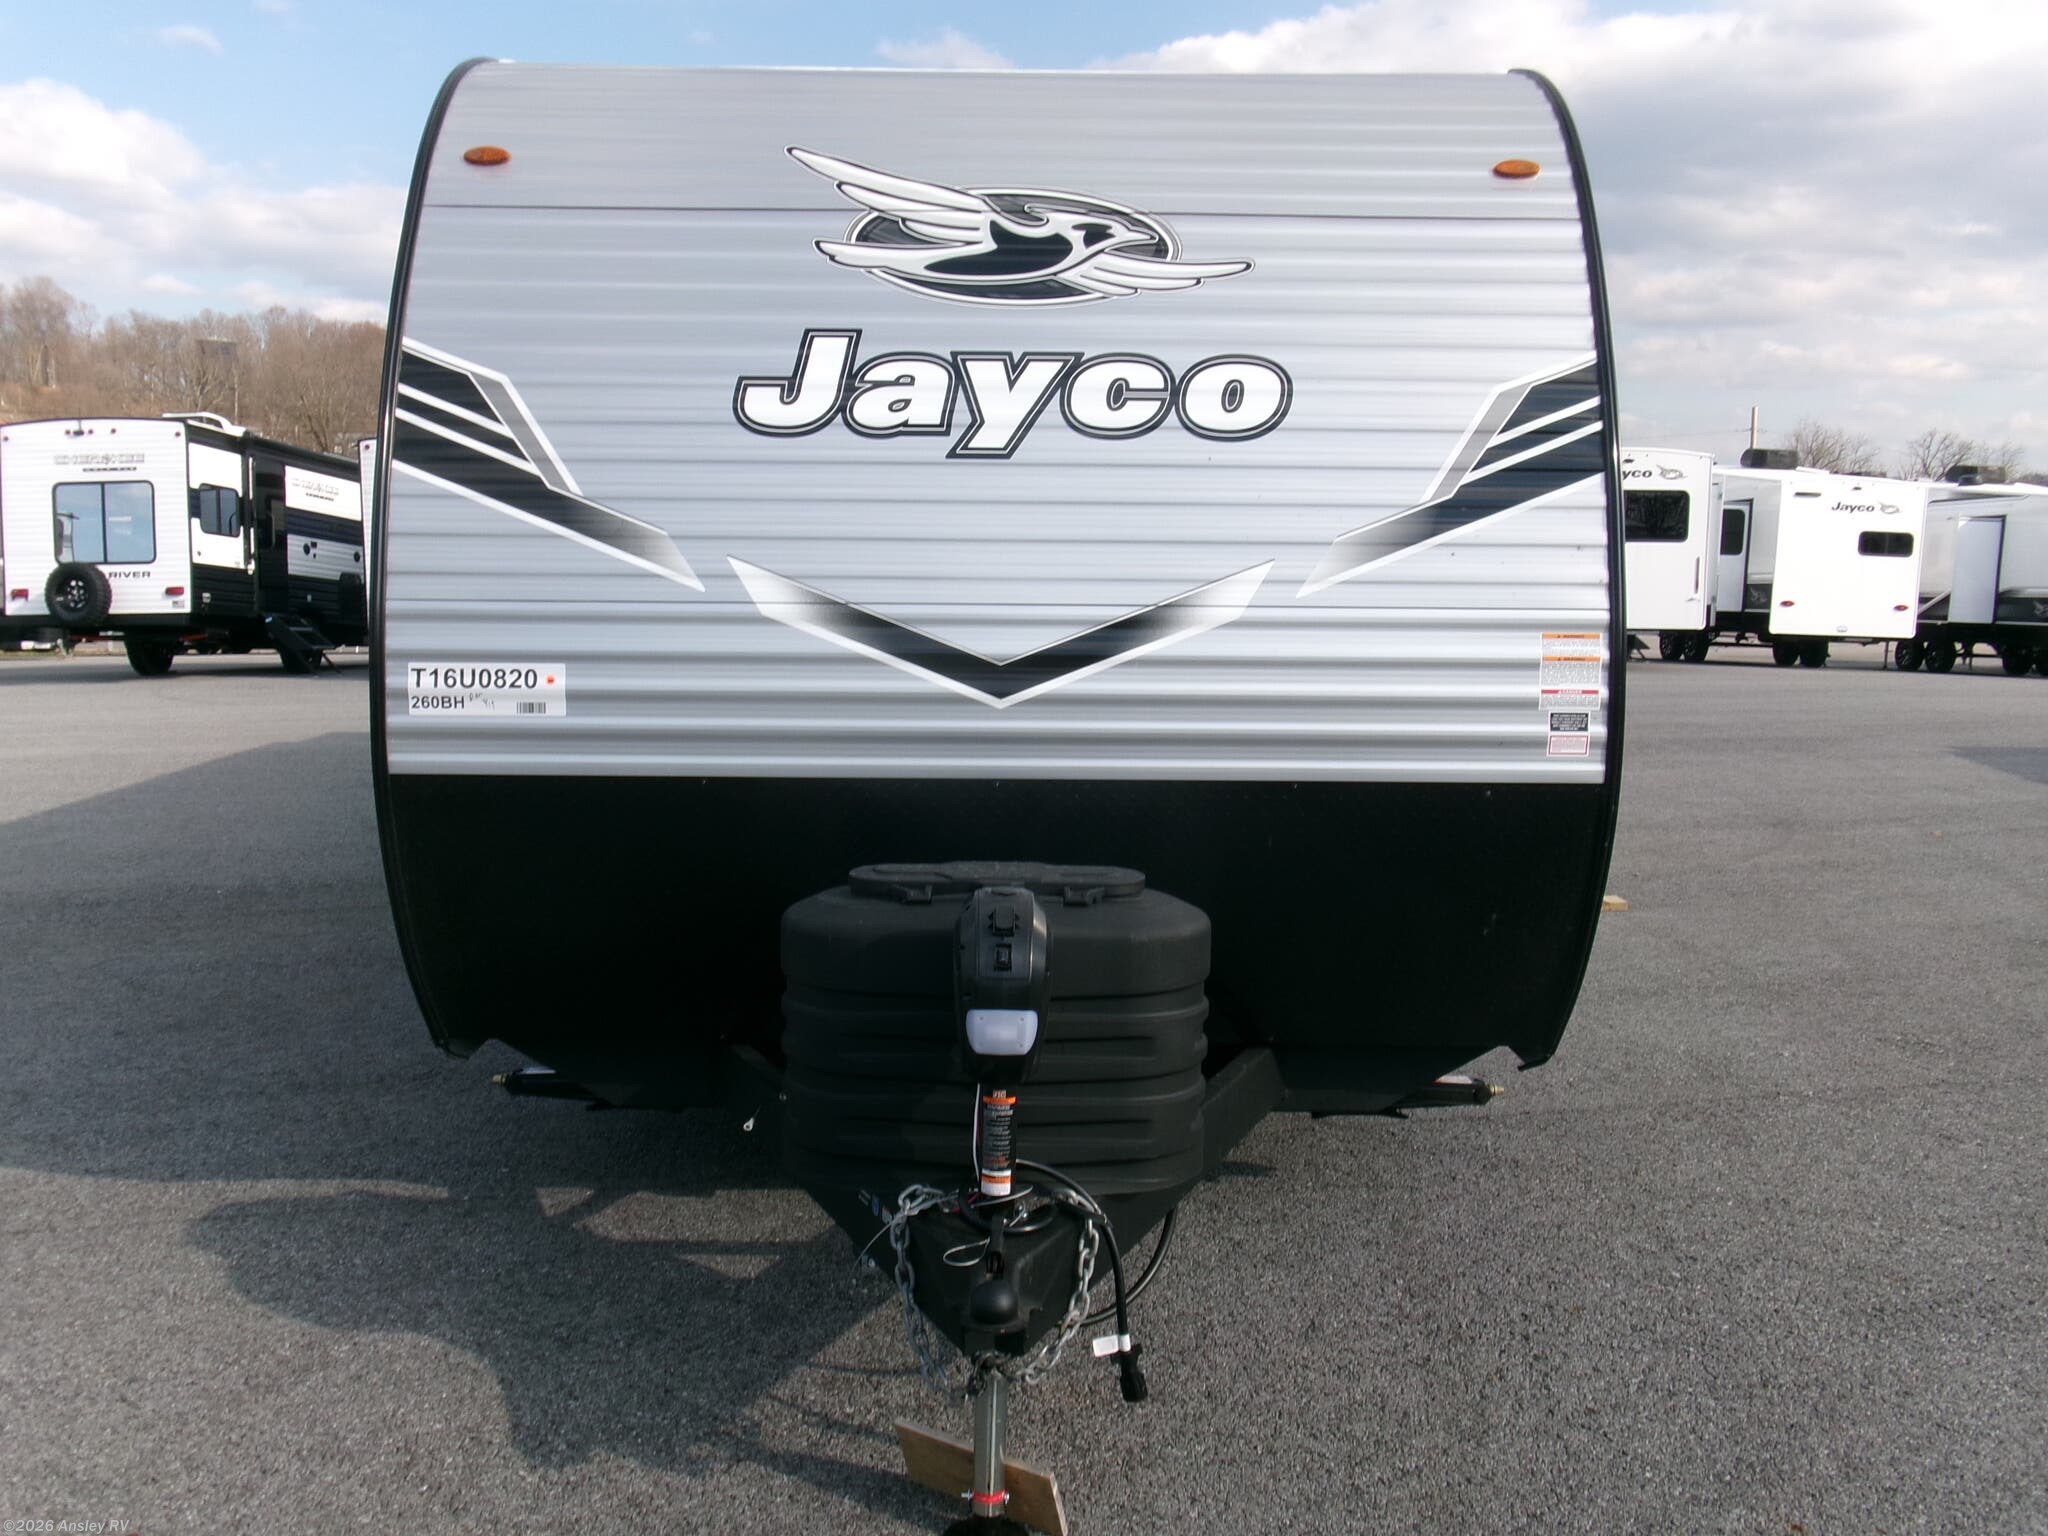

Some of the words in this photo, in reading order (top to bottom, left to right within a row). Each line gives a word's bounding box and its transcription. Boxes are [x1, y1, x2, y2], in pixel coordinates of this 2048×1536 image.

[733, 328, 1294, 459] Jayco
[1622, 470, 1653, 480] yco
[1832, 501, 1875, 513] Jayco
[411, 668, 538, 688] T16U0820
[411, 696, 465, 709] 260BH
